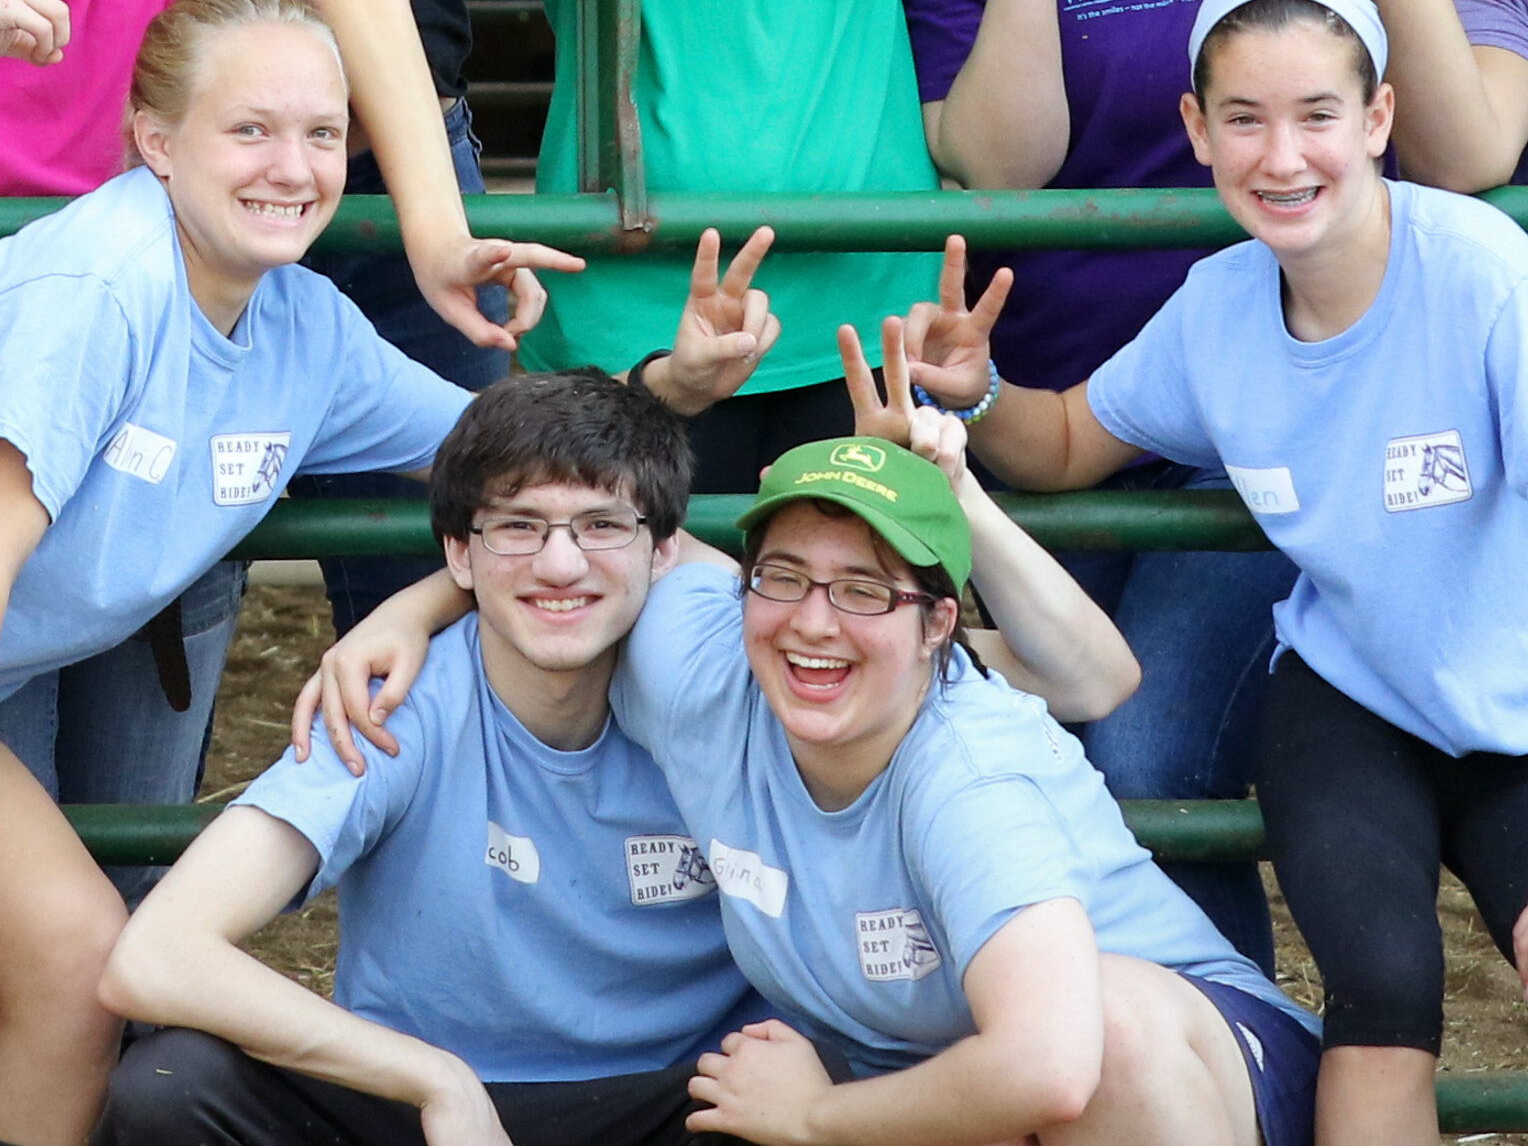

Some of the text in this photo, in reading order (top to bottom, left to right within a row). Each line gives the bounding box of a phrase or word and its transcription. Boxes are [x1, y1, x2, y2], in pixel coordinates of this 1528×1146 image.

[217, 441, 260, 453] READY
[219, 463, 245, 475] SET
[1386, 468, 1405, 482] SET
[220, 486, 251, 499] RIDE!
[794, 471, 899, 503] JOHN DEERE
[630, 841, 675, 855] READY
[633, 862, 660, 877] SET
[636, 884, 673, 900] RIDE!
[859, 915, 904, 932] READY
[863, 940, 890, 954] SET
[865, 961, 902, 975] RIDE!
